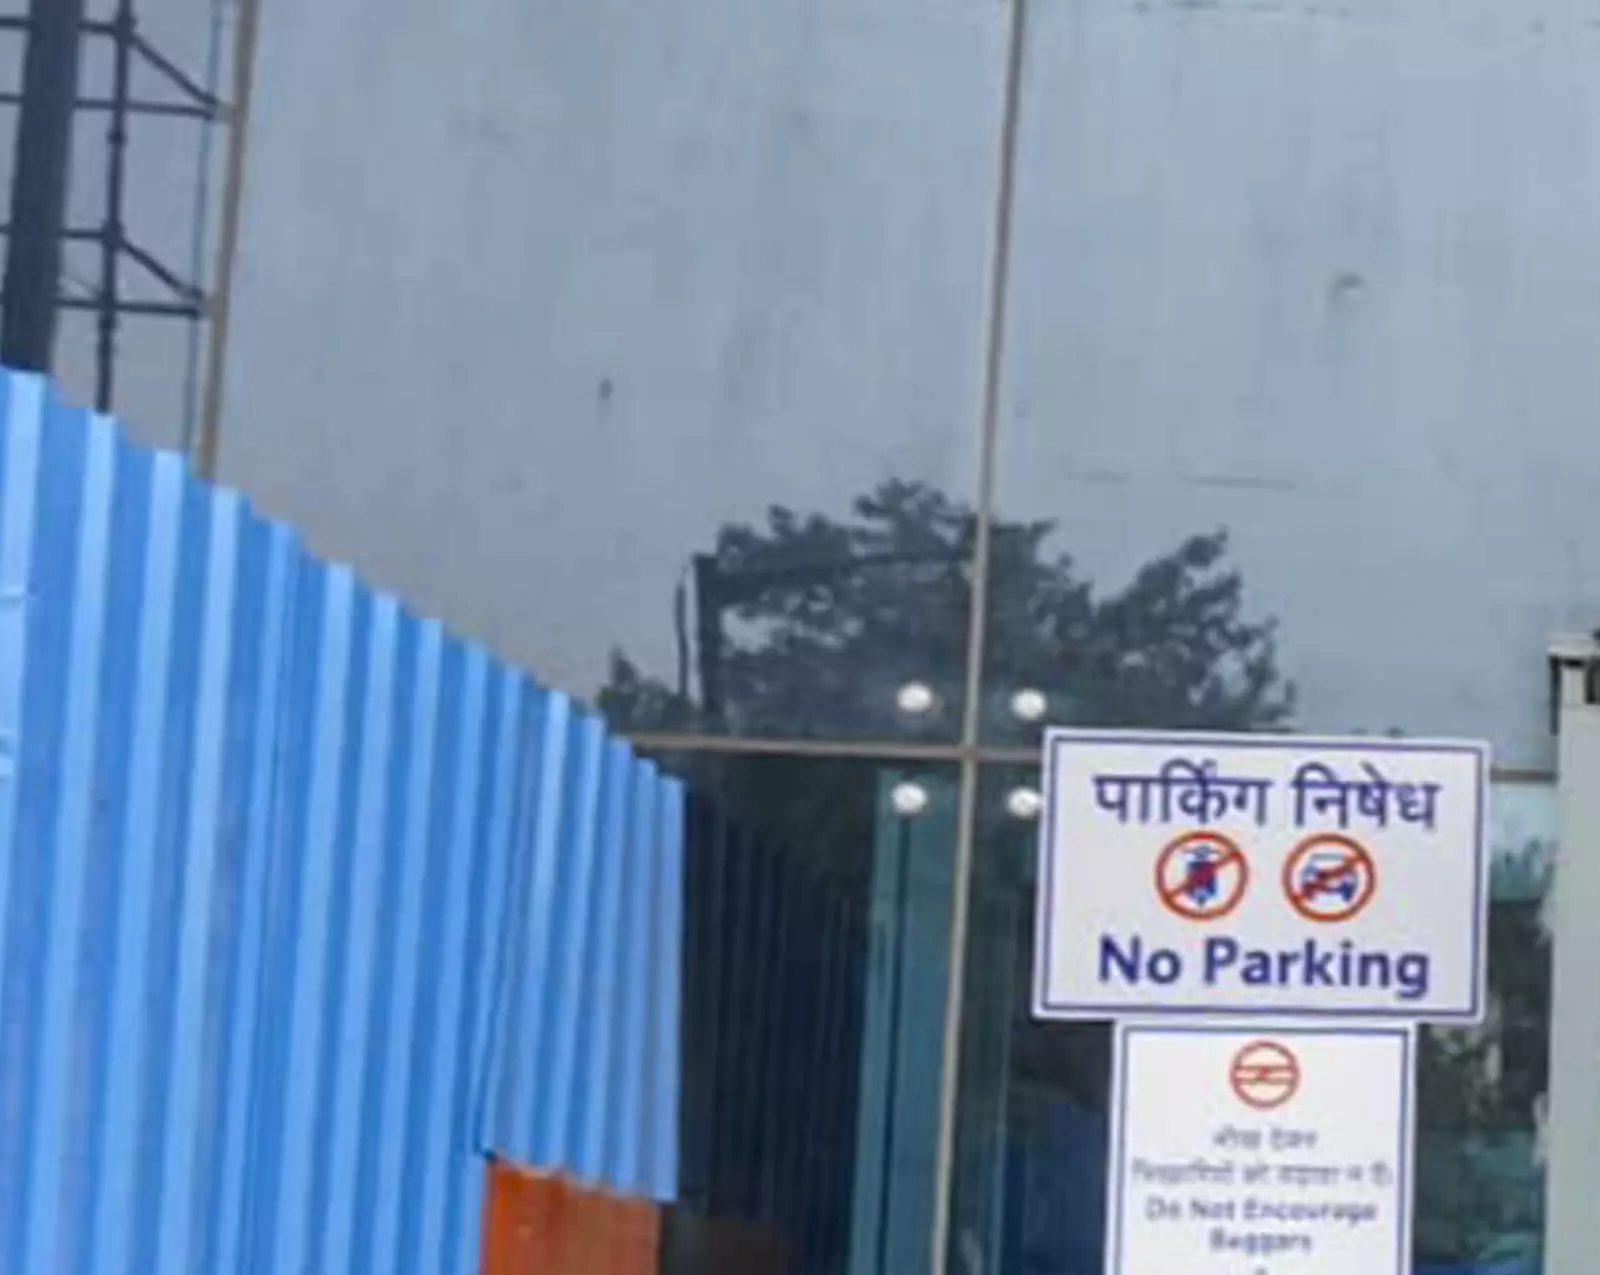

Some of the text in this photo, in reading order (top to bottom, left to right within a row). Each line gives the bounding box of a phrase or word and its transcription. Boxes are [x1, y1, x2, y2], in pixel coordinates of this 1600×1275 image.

[1092, 758, 1443, 830] पार्किंग निषेध
[1098, 934, 1431, 998] No Parking
[1144, 1197, 1378, 1229] Do Not Encourage
